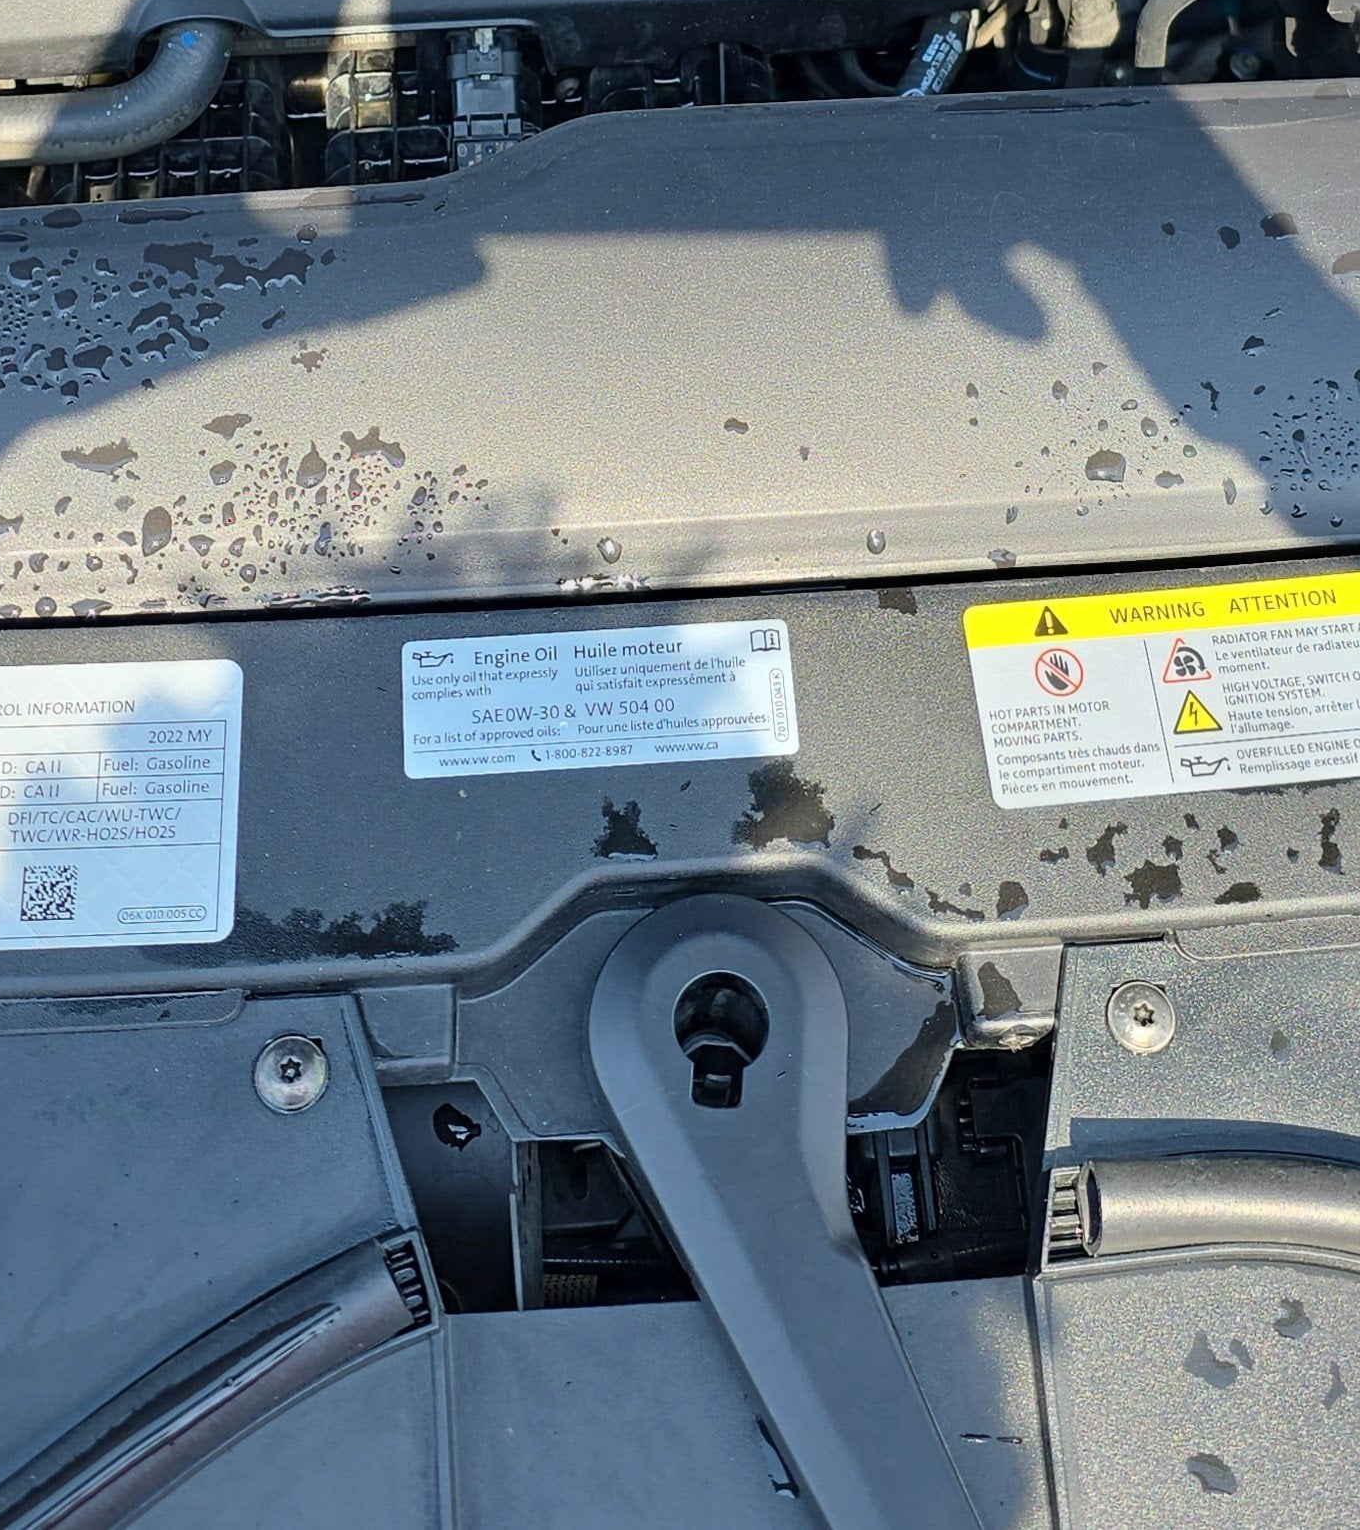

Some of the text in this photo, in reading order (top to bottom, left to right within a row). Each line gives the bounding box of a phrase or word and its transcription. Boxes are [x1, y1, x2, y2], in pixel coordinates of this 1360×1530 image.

[1108, 589, 1337, 624] WARNING ATTENTION
[1211, 630, 1269, 646] RADIATOR
[1269, 628, 1293, 640] FAN
[1294, 626, 1319, 638] MAY
[1320, 622, 1354, 636] START
[474, 645, 557, 668] Engine Oil
[574, 641, 683, 659] Huile moteur
[411, 666, 559, 687] Use only oil that expressly
[574, 656, 746, 678] Utilisez uniquement de l'huile
[575, 670, 736, 694] qui satisfait expressément à
[1221, 681, 1251, 694] HIGH
[1250, 676, 1305, 691] VOLTAGE,
[1306, 671, 1351, 686] SWITCH
[411, 684, 492, 702] complies with
[1224, 687, 1325, 706] IGNITION SYSTEM.
[27, 699, 135, 716] INFORMATION
[564, 703, 576, 719] &
[584, 701, 614, 717] VW
[618, 699, 649, 715] 504
[654, 697, 675, 713] 00
[989, 700, 1110, 721] HOT PARTS IN MOTOR
[577, 711, 770, 735] Pour une liste d'huiles approuvées:
[991, 716, 1082, 735] COMPARTMENT.
[148, 729, 212, 744] 2022 MY
[413, 725, 561, 745] For a list of approved oils:
[993, 730, 1083, 748] MOVING PARTS.
[545, 744, 633, 760] 1-800-822-8987
[654, 741, 719, 753] www.vw.ca
[1236, 743, 1306, 760] OVERFILLED
[1307, 738, 1352, 753] ENGINE
[25, 760, 47, 774] CA
[103, 754, 211, 772] Fuel: Gasoline
[439, 754, 516, 767] www.vw.com
[23, 784, 45, 799] CA
[102, 779, 210, 796] Fuel: Gasoline
